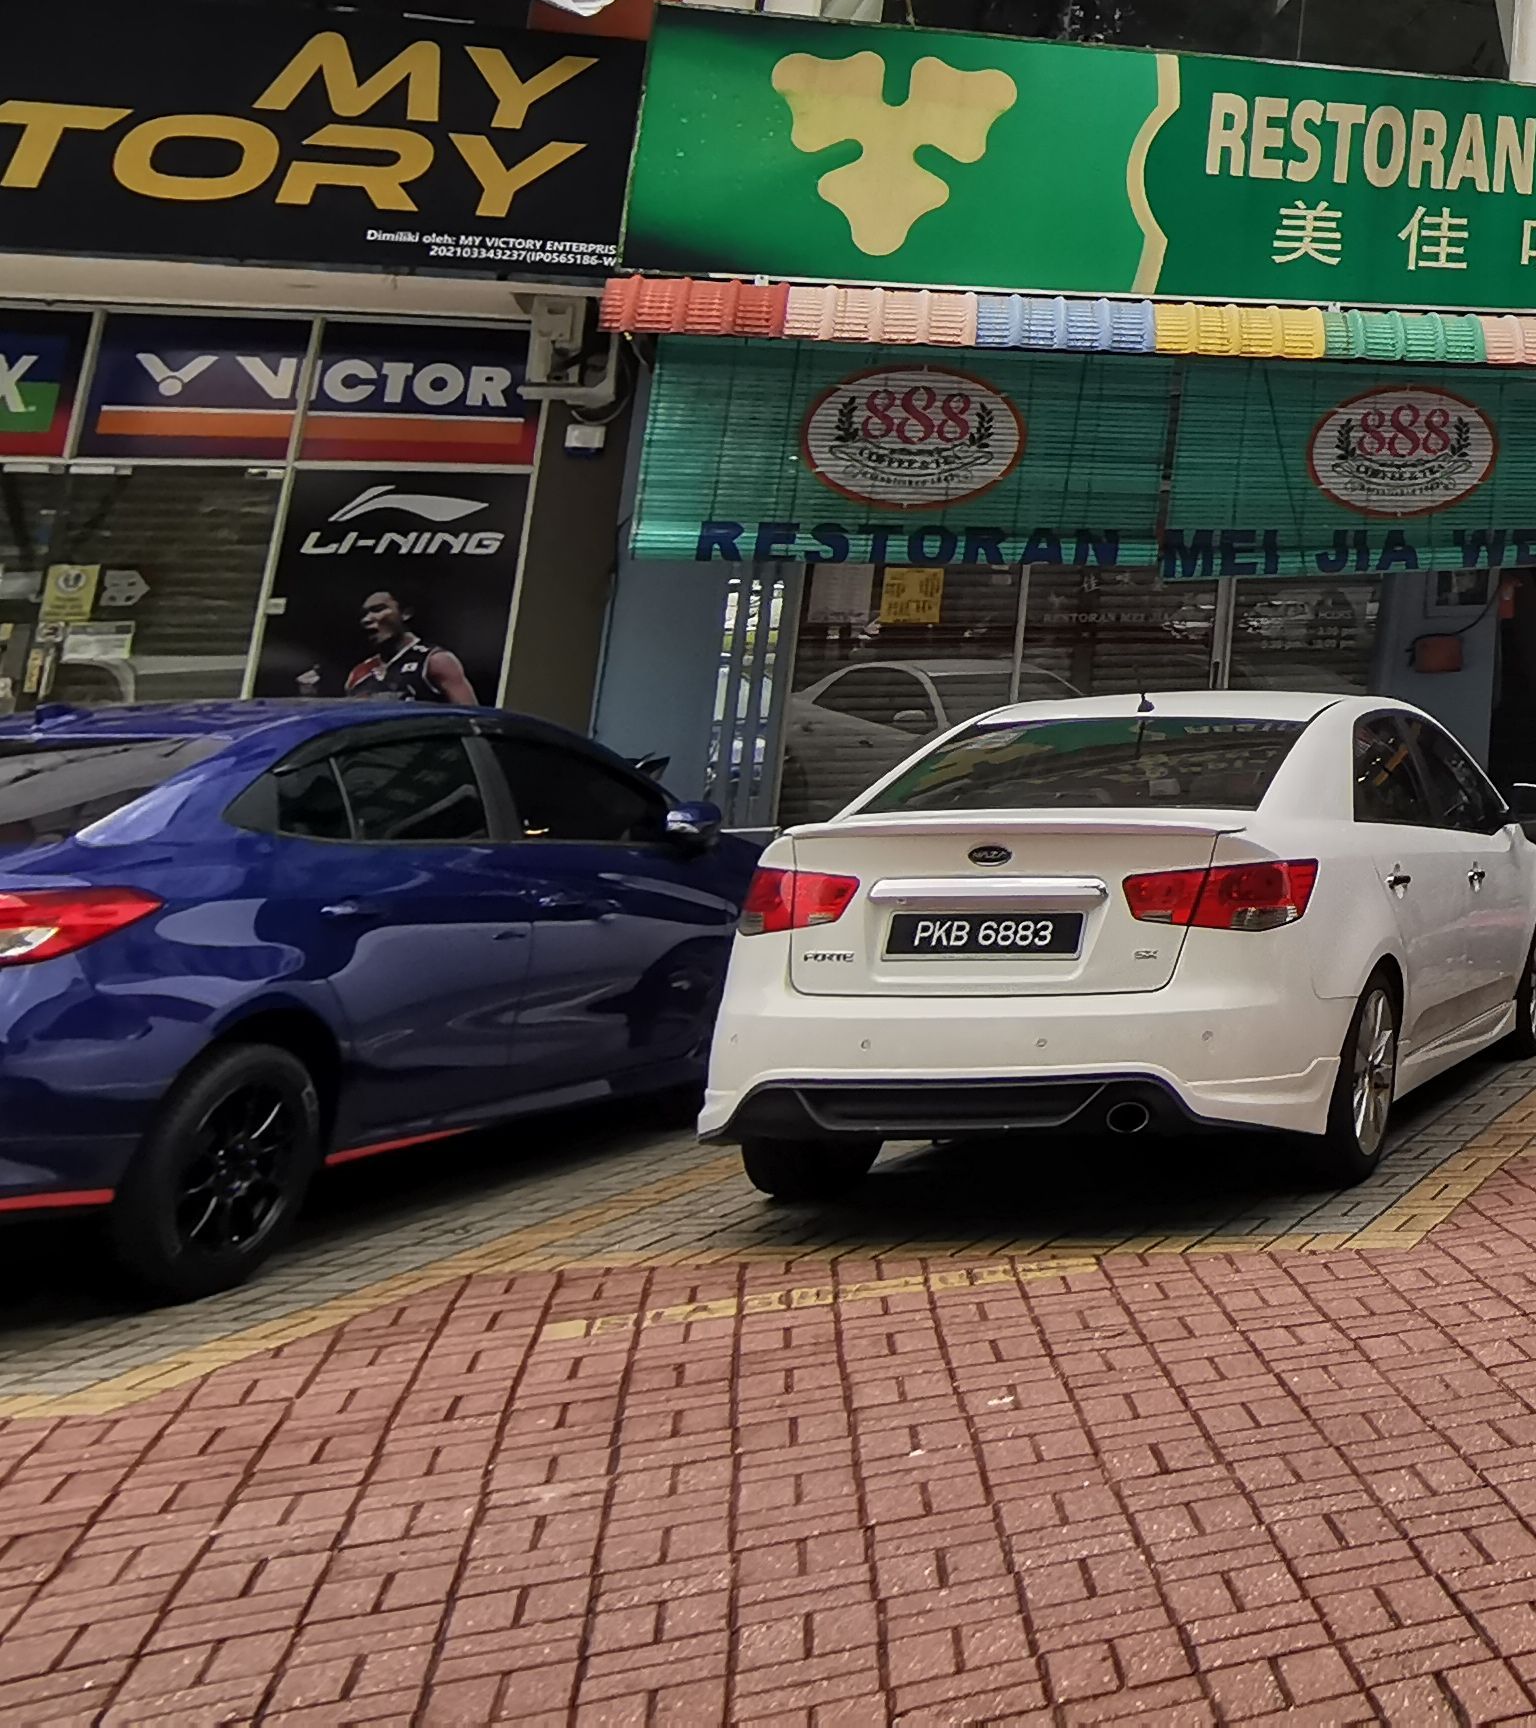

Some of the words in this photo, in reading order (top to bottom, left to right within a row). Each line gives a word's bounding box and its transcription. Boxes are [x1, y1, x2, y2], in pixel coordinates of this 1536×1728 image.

[251, 29, 600, 130] MY
[0, 99, 588, 218] TORY
[366, 229, 419, 243] Dimiliki
[422, 233, 455, 245] oleh:
[459, 235, 482, 248] MY
[486, 237, 542, 251] VICTORY
[861, 386, 971, 445] 888
[1357, 403, 1451, 459] 888
[300, 530, 504, 556] LI-NING
[695, 521, 1121, 565] RESTORAN
[1163, 529, 1281, 578] MEI
[1315, 529, 1419, 572] JIA
[912, 921, 968, 947] PKB
[977, 920, 1053, 947] 6883
